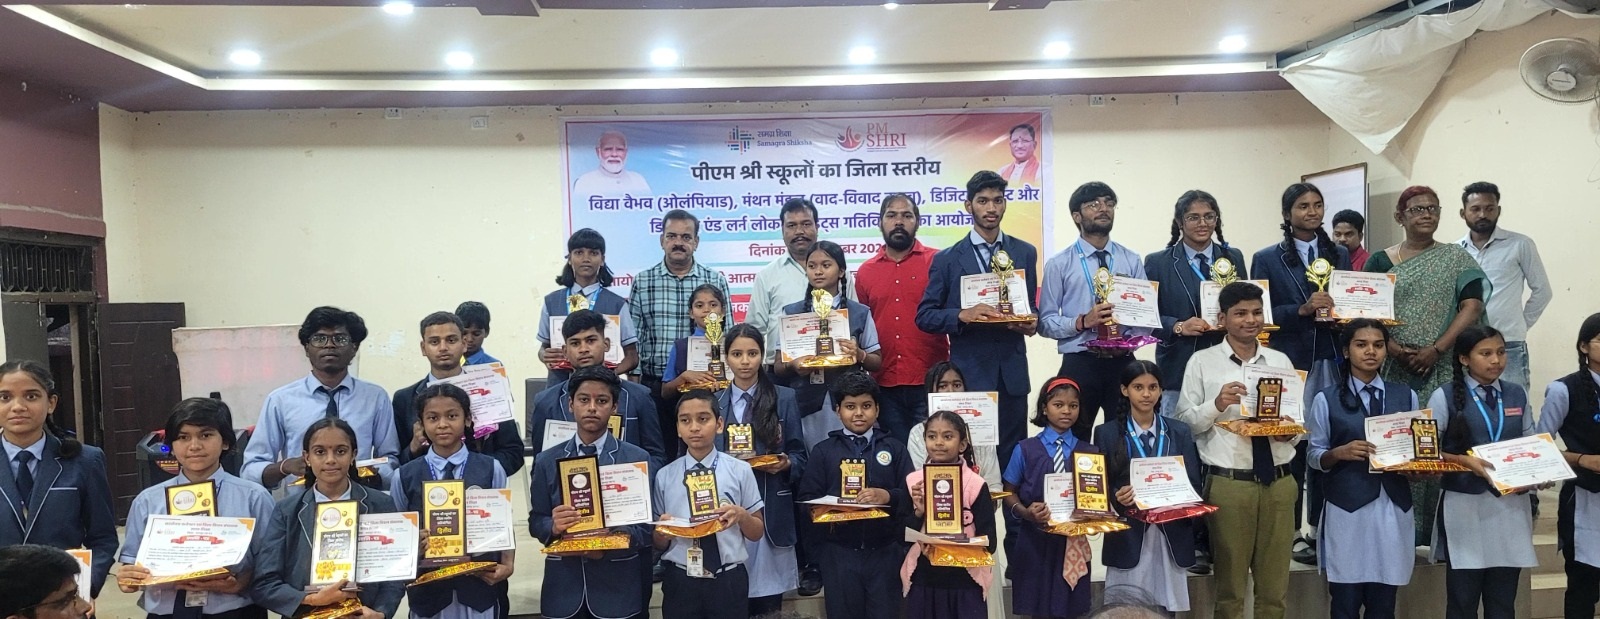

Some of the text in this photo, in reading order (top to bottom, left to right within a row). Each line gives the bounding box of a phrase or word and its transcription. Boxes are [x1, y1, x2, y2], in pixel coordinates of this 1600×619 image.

[866, 122, 888, 133] PM
[757, 139, 813, 148] Samagra Shiksha
[866, 133, 907, 147] SHRI
[691, 156, 942, 185] पीएम श्री स्कूलों का जिला स्तरीय
[589, 194, 620, 211] विद्या
[623, 193, 653, 210] वैभव
[657, 192, 737, 212] (ओलंपियाड),
[742, 192, 771, 207] मंथन
[810, 188, 881, 206] (वाद-विवाद
[930, 186, 968, 202] डिजिट
[1017, 185, 1040, 201] और
[704, 216, 722, 231] एंड
[725, 214, 747, 231] लर्न
[936, 210, 974, 226] आयोज
[749, 243, 786, 257] दिनांक
